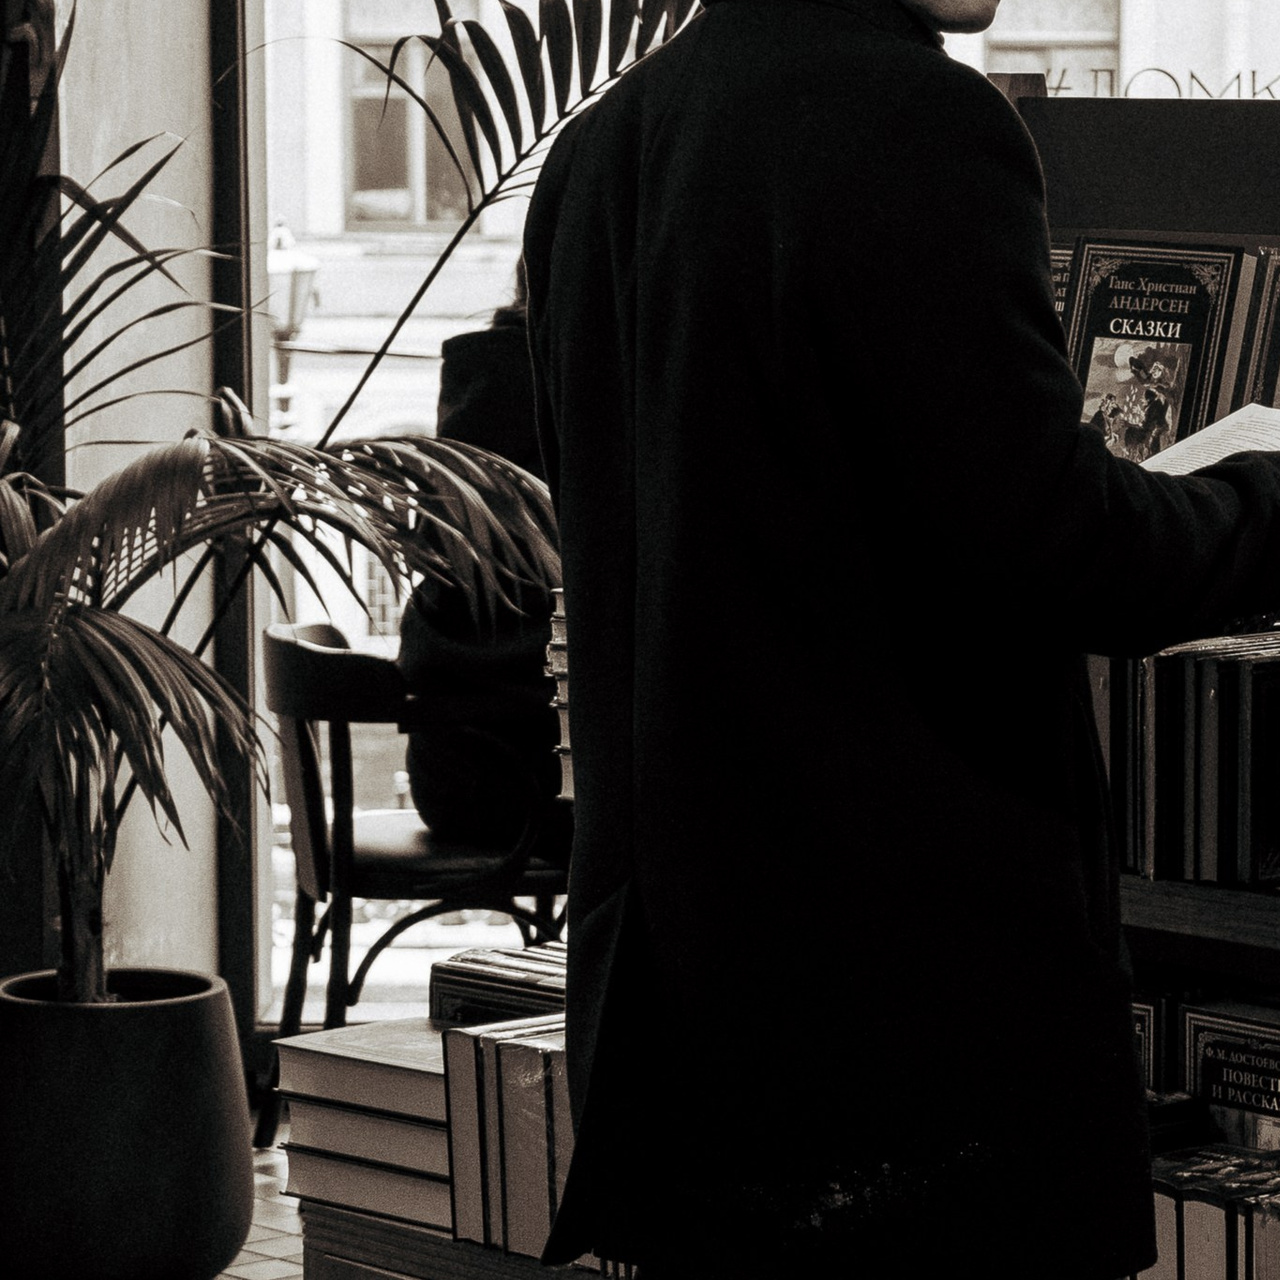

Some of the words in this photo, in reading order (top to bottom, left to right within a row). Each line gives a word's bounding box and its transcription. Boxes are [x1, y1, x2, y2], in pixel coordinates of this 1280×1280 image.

[1108, 275, 1135, 290] Ганс
[1138, 277, 1197, 295] Христиан
[1108, 295, 1190, 314] АНДЕРСЕН
[1109, 317, 1182, 339] СКАЗКИ
[1211, 1083, 1222, 1100] И
